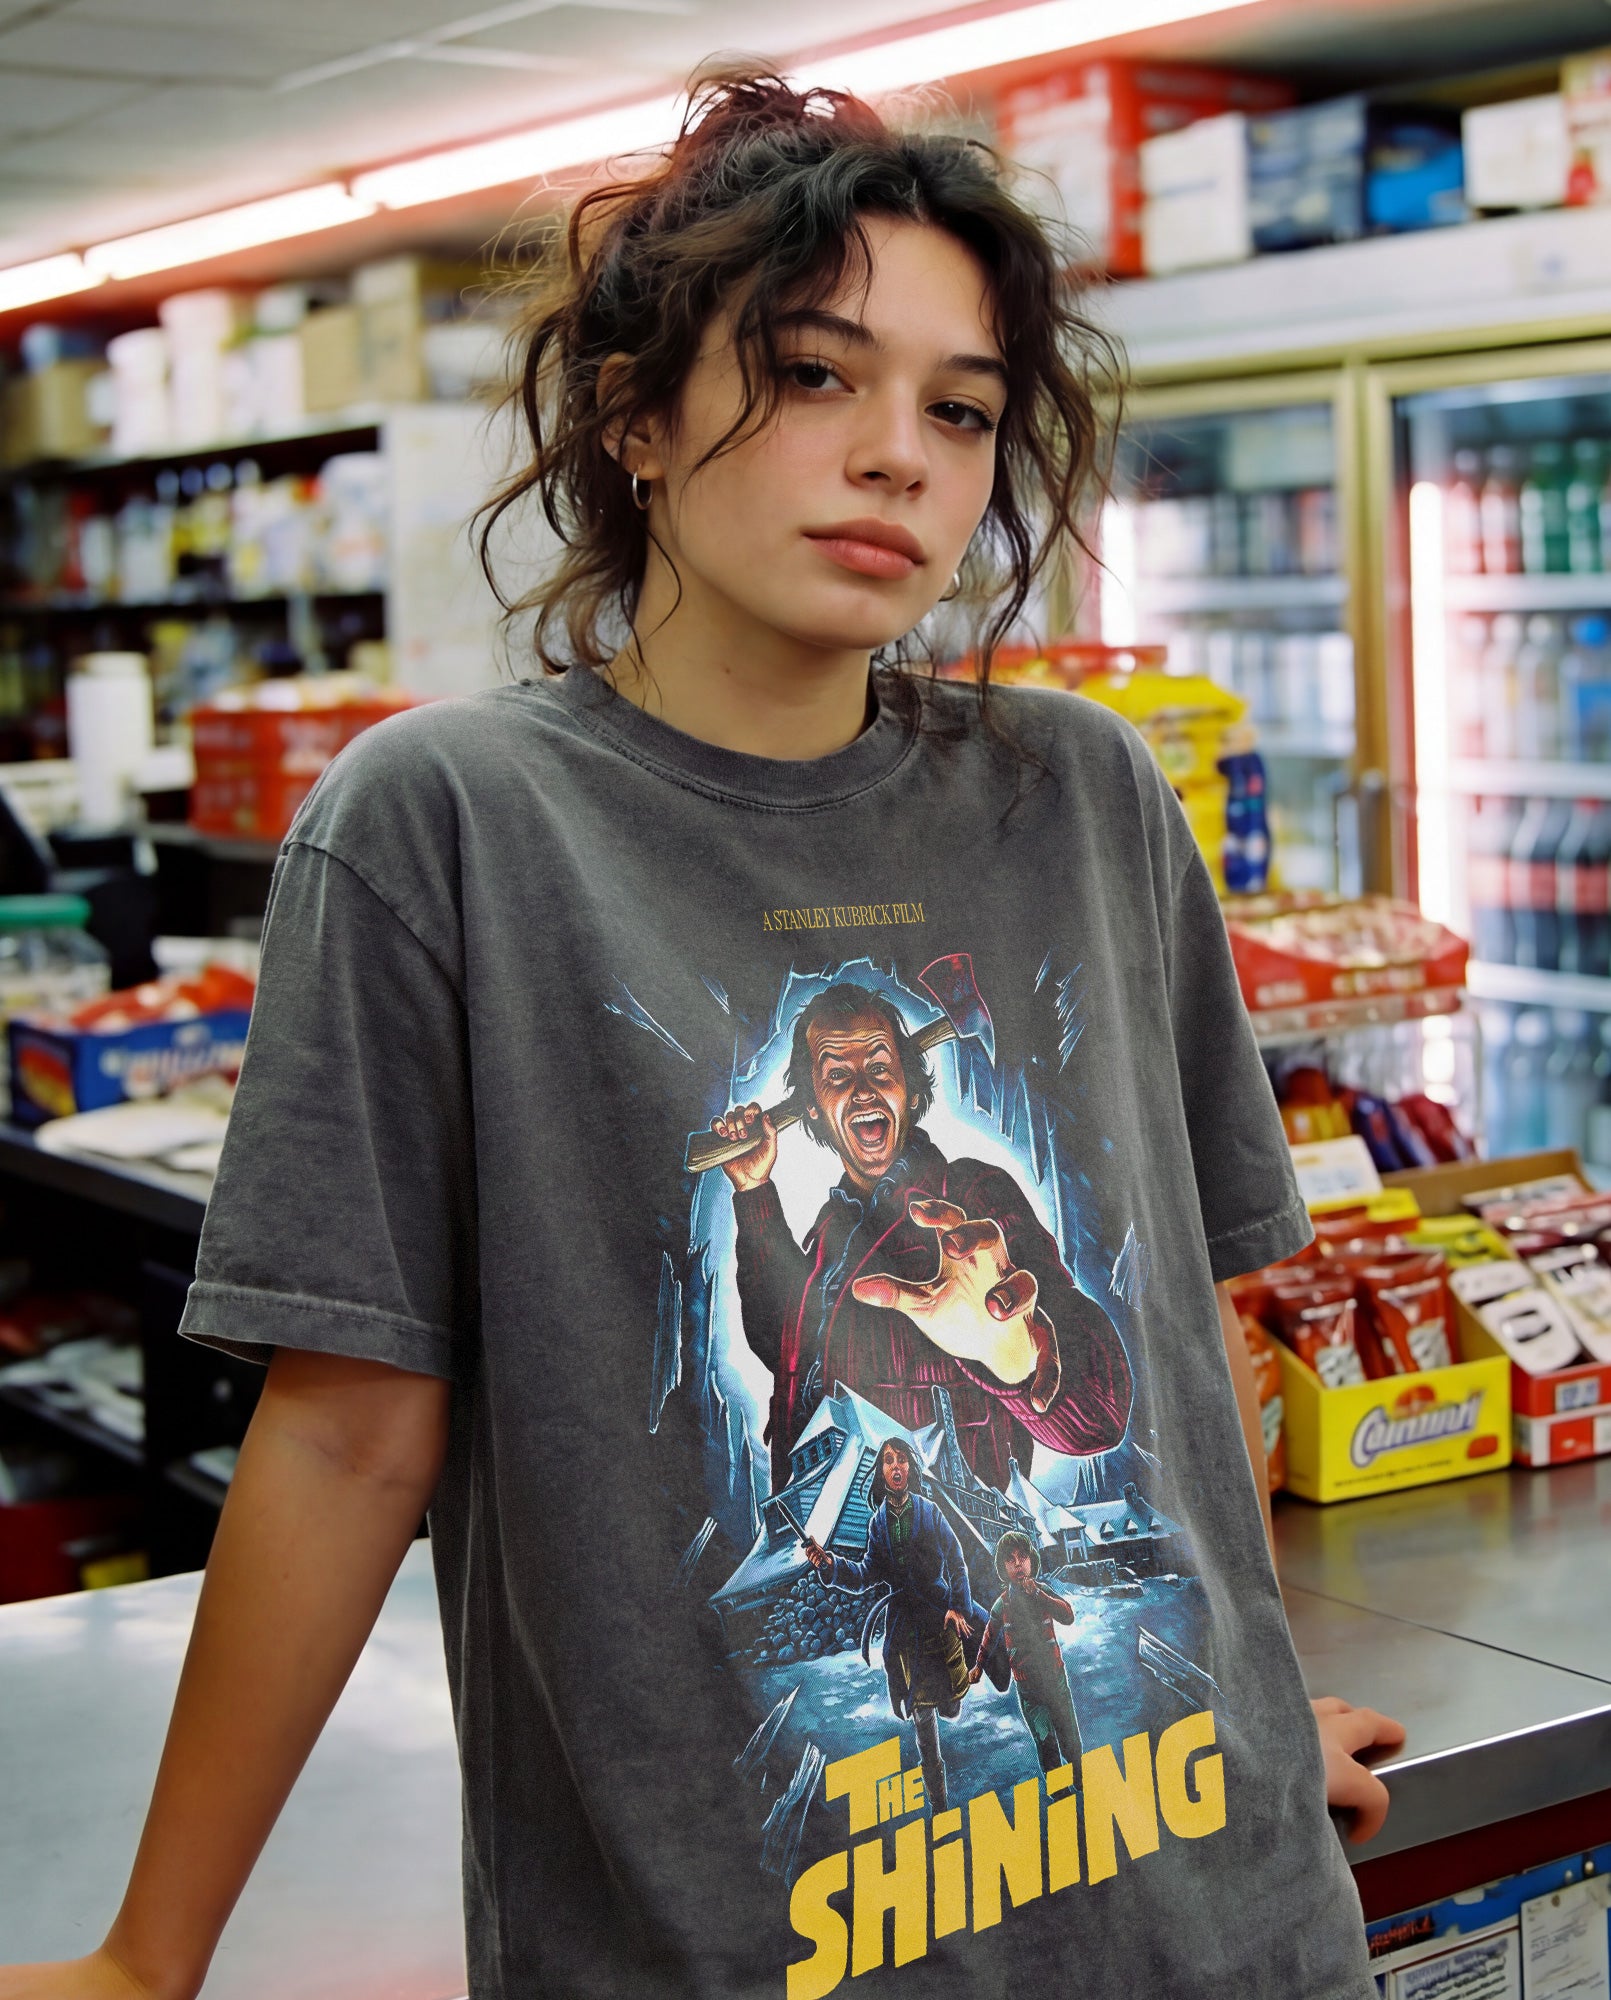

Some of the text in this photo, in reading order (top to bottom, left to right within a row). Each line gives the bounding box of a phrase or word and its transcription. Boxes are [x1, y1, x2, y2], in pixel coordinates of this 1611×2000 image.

[763, 903, 926, 931] A STANLEY KUBRICK FILM
[825, 1736, 925, 1835] THE
